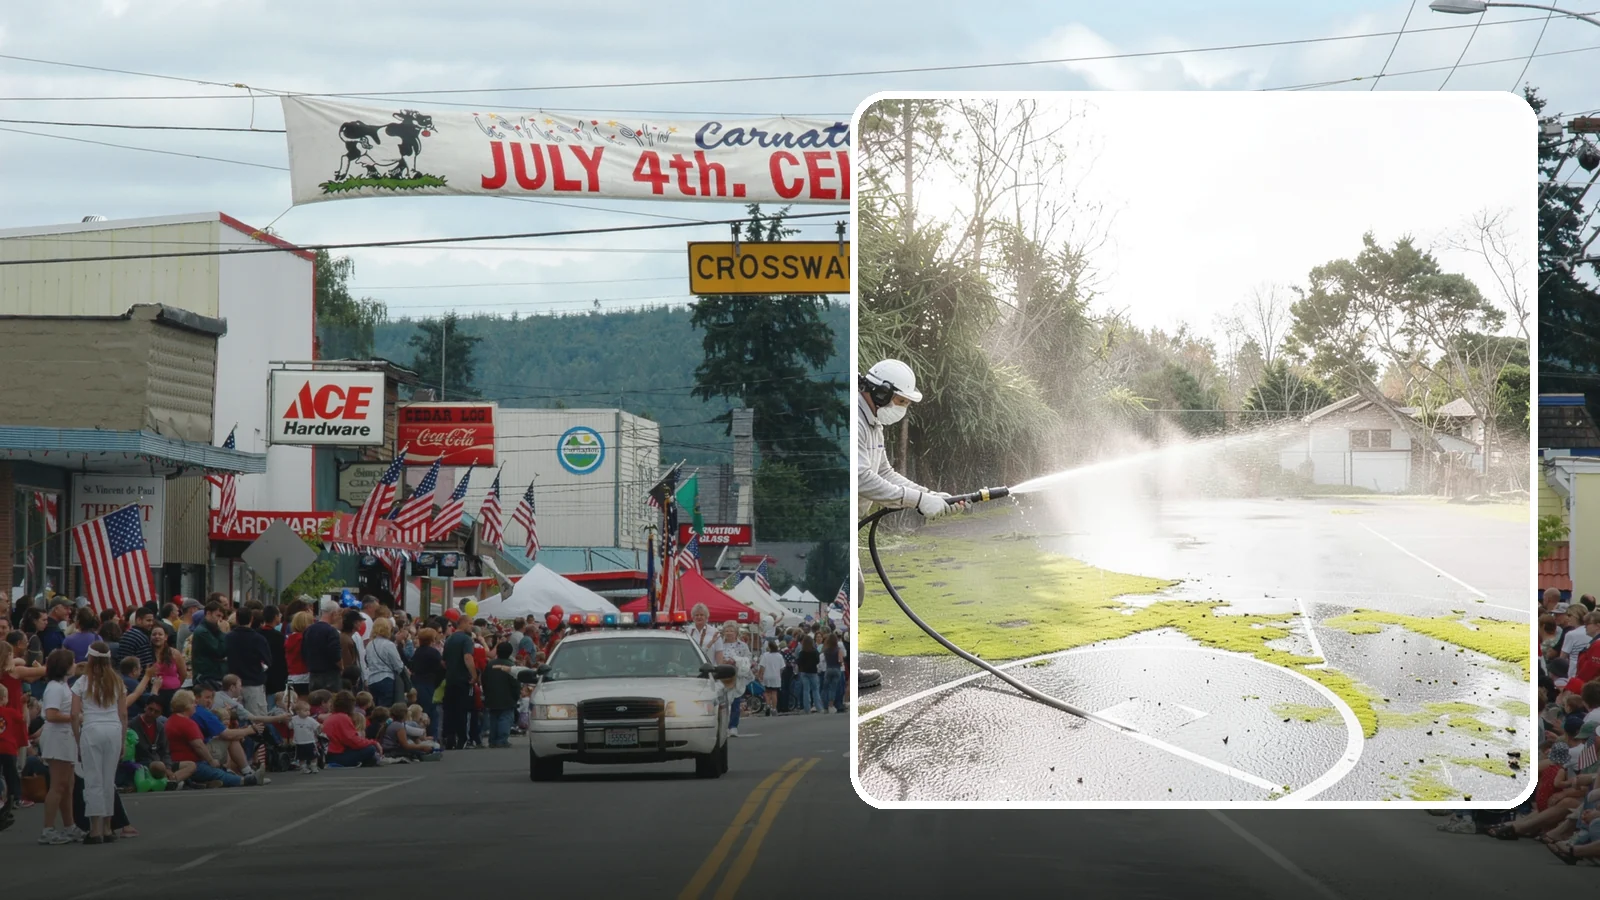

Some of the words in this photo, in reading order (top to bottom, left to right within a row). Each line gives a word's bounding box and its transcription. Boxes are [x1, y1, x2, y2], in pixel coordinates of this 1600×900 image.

[481, 141, 605, 192] JULY
[632, 149, 746, 198] 4th.
[697, 254, 850, 280] CROSSWA
[283, 380, 373, 420] ACE
[405, 409, 452, 422] CEDAR
[461, 409, 485, 421] LOG
[283, 421, 370, 436] Hardware
[416, 428, 477, 447] Coca-Cola
[353, 467, 385, 480] Simpl
[83, 485, 93, 494] St.
[96, 485, 123, 495] Vincent
[126, 486, 135, 495] de
[138, 486, 155, 495] Paul
[688, 526, 741, 535] CRNATION
[699, 535, 730, 543] GLASS
